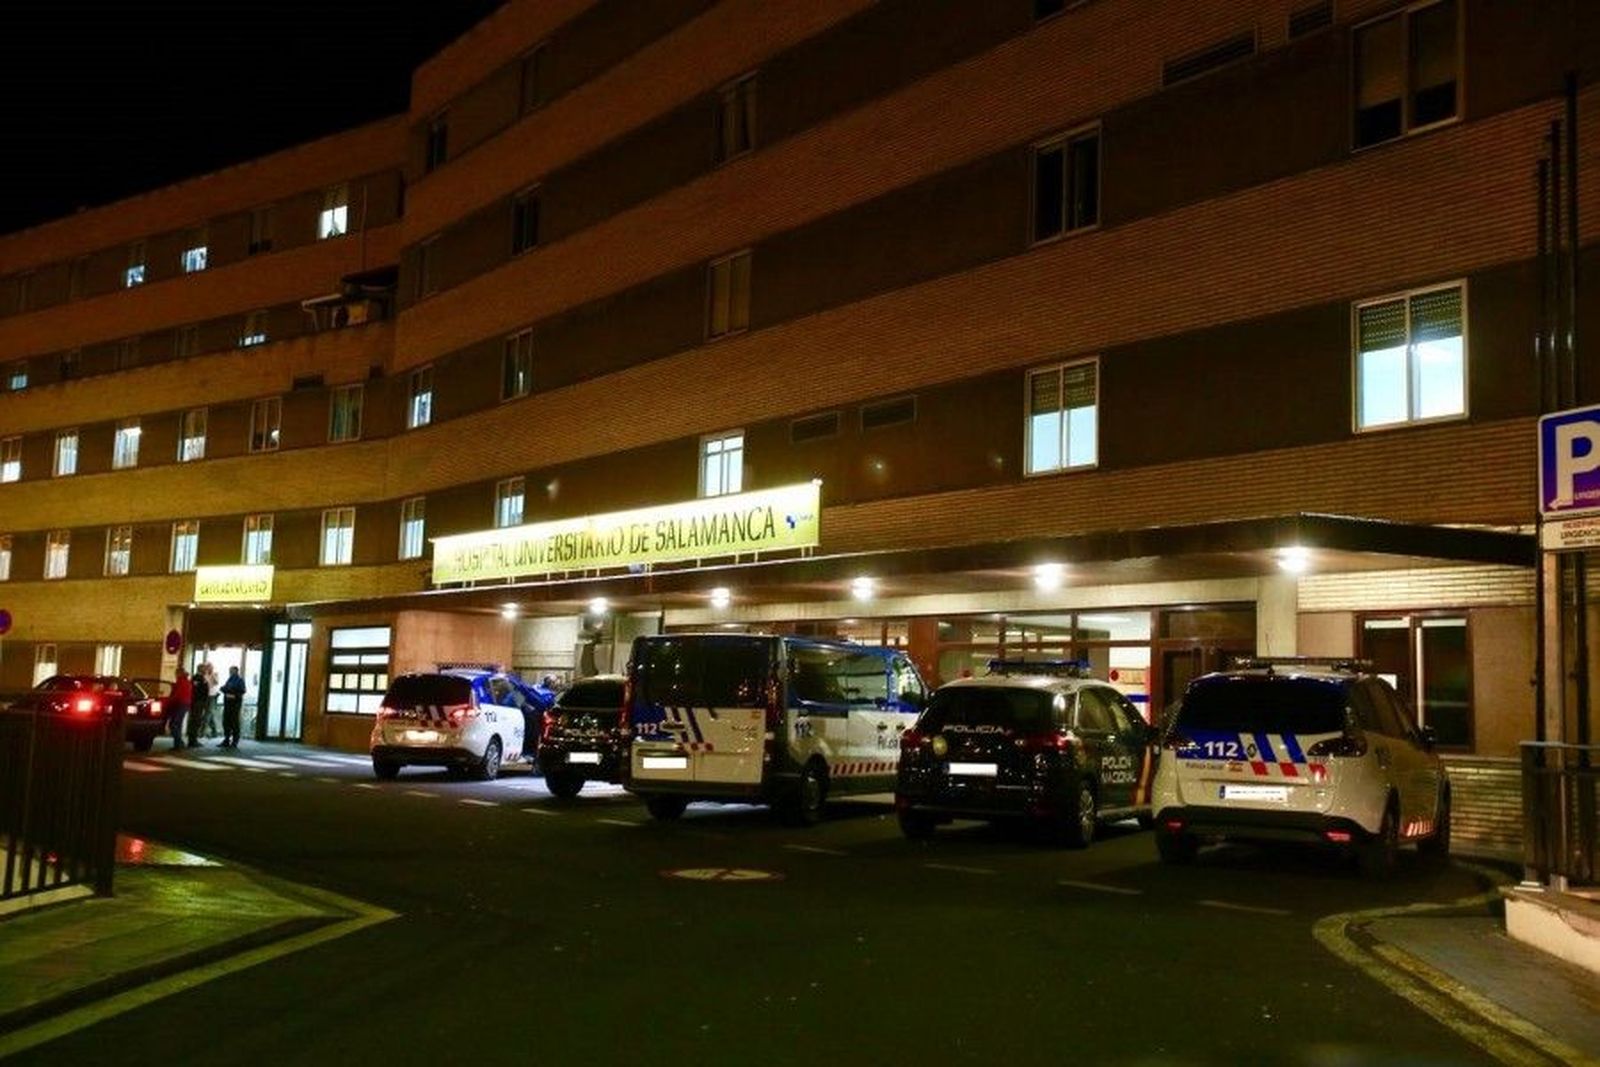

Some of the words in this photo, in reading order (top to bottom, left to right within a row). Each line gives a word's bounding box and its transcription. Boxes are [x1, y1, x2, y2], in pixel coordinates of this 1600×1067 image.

[1556, 421, 1600, 503] P
[629, 523, 650, 554] DE
[655, 505, 776, 552] SALAMANCA
[635, 722, 658, 736] 112
[1204, 741, 1239, 757] 112
